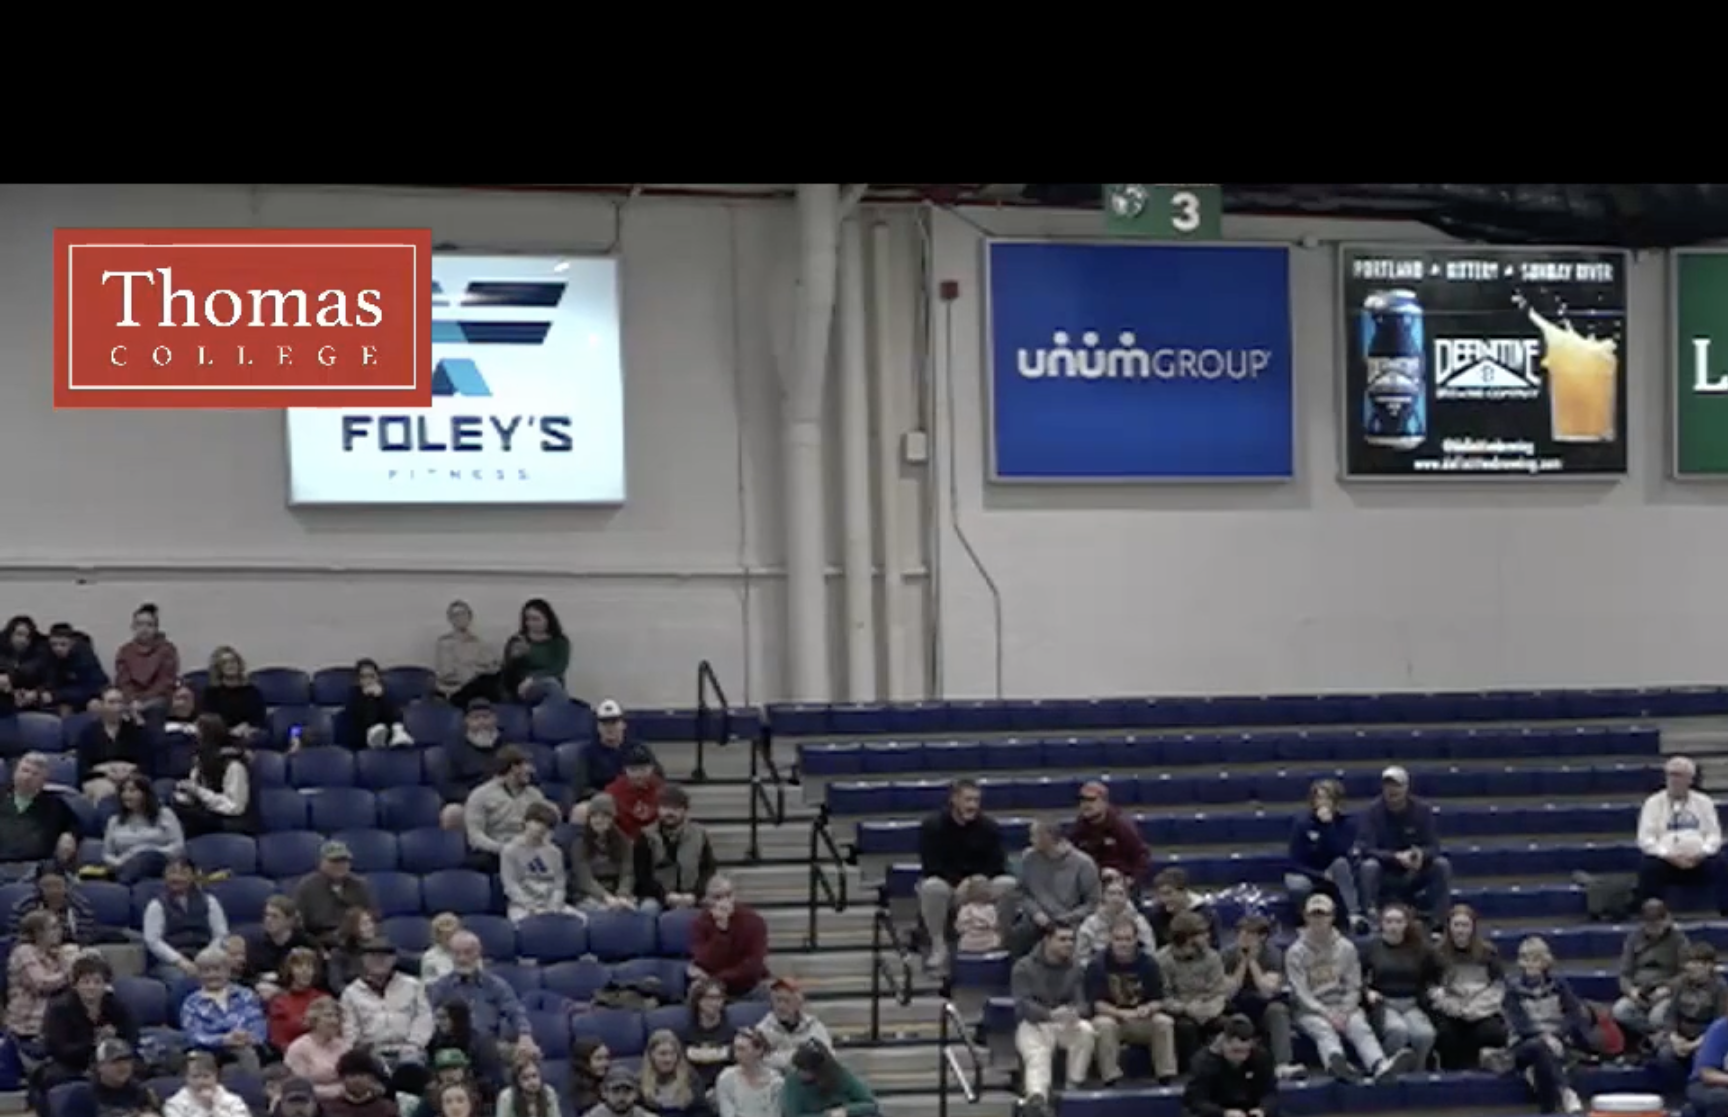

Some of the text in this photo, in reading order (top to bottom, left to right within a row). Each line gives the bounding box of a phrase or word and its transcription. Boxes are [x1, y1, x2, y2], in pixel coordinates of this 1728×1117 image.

[1172, 191, 1201, 232] 3
[1434, 338, 1541, 385] DEFINITIVE
[341, 415, 574, 452] FOLEY'S
